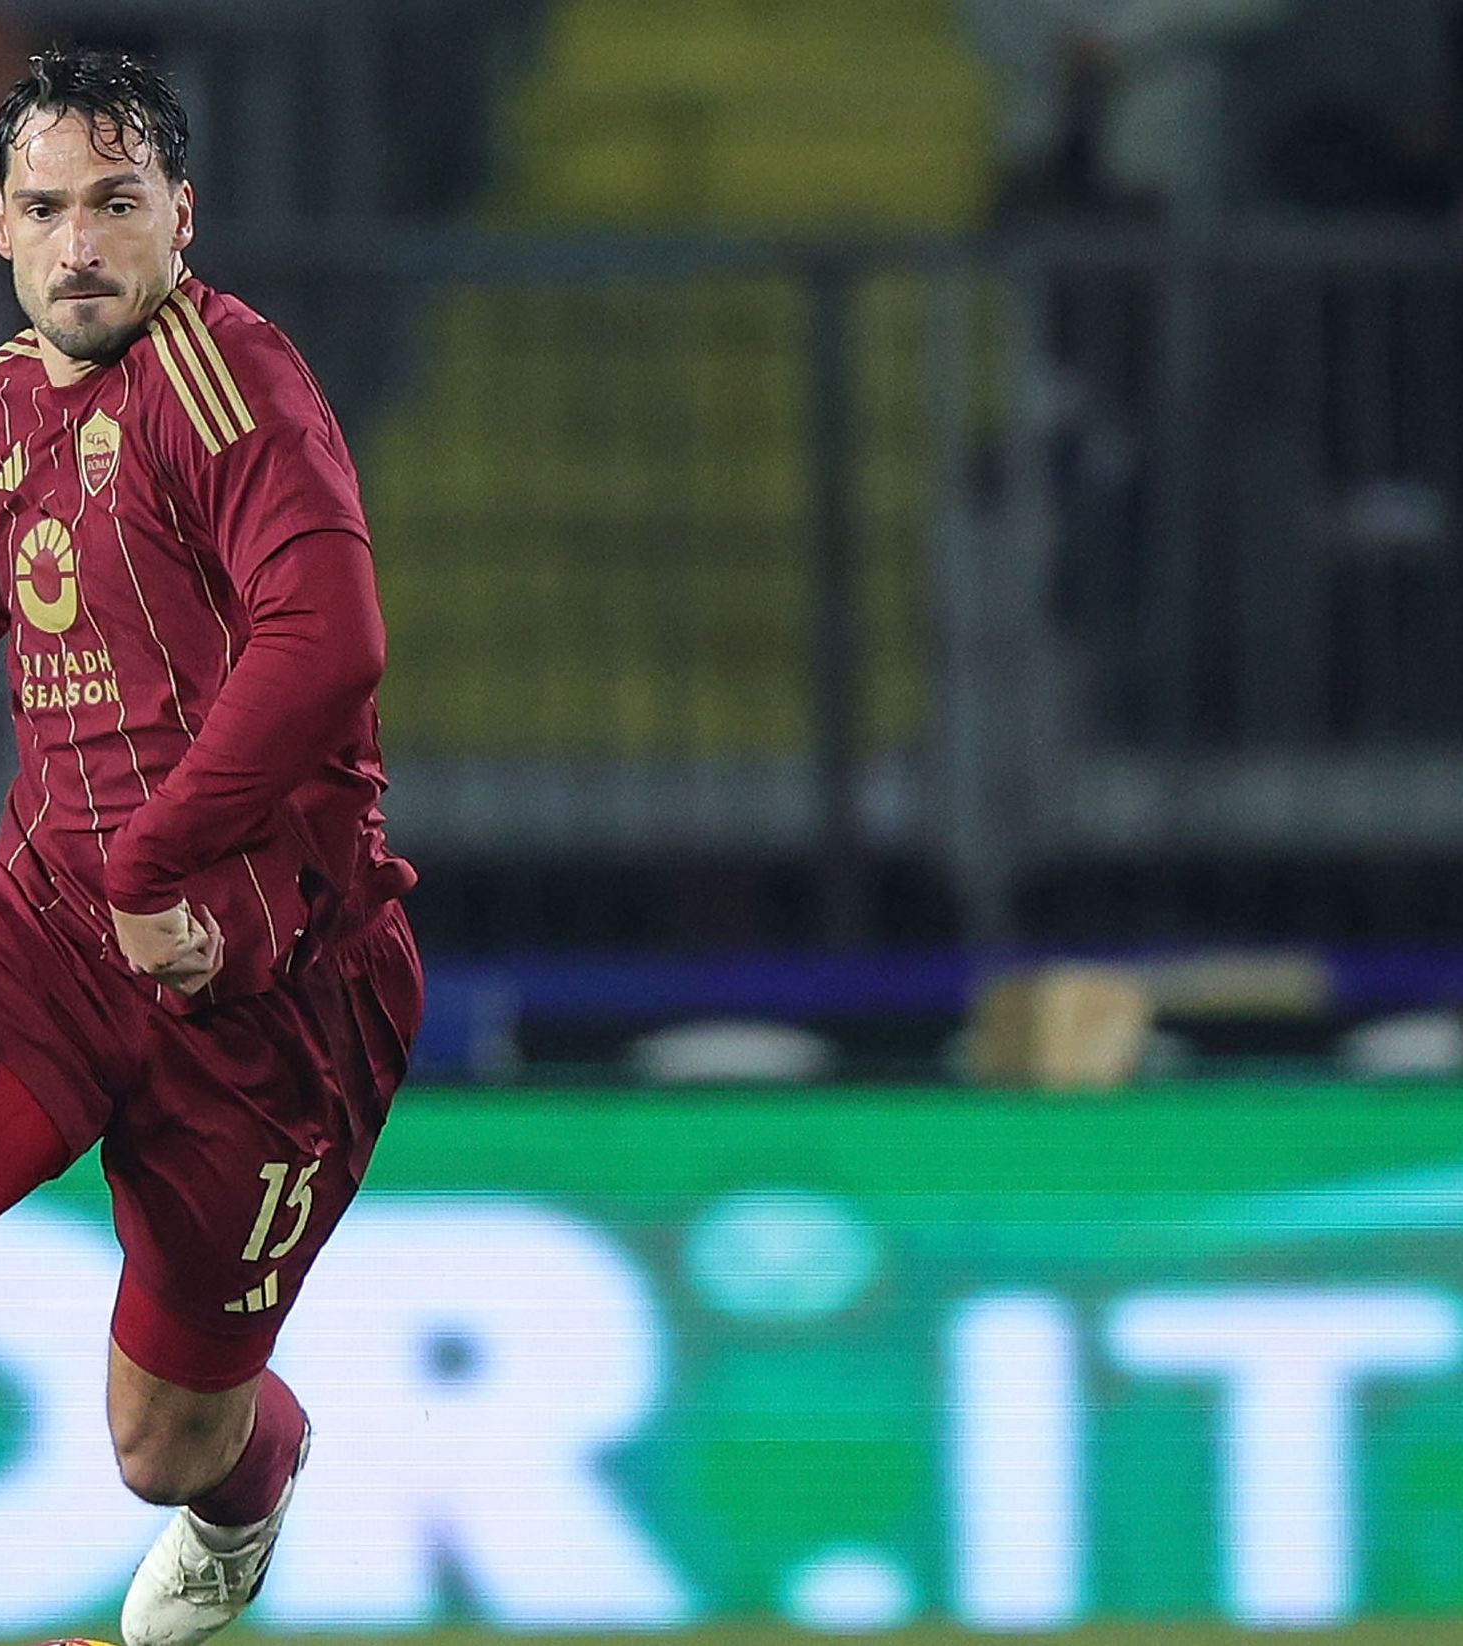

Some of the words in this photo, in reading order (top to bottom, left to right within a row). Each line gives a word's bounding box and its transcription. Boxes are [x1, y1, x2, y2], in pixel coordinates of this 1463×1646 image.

[20, 649, 113, 679] RIYADH
[23, 678, 121, 709] SEASON
[241, 1159, 321, 1261] 15
